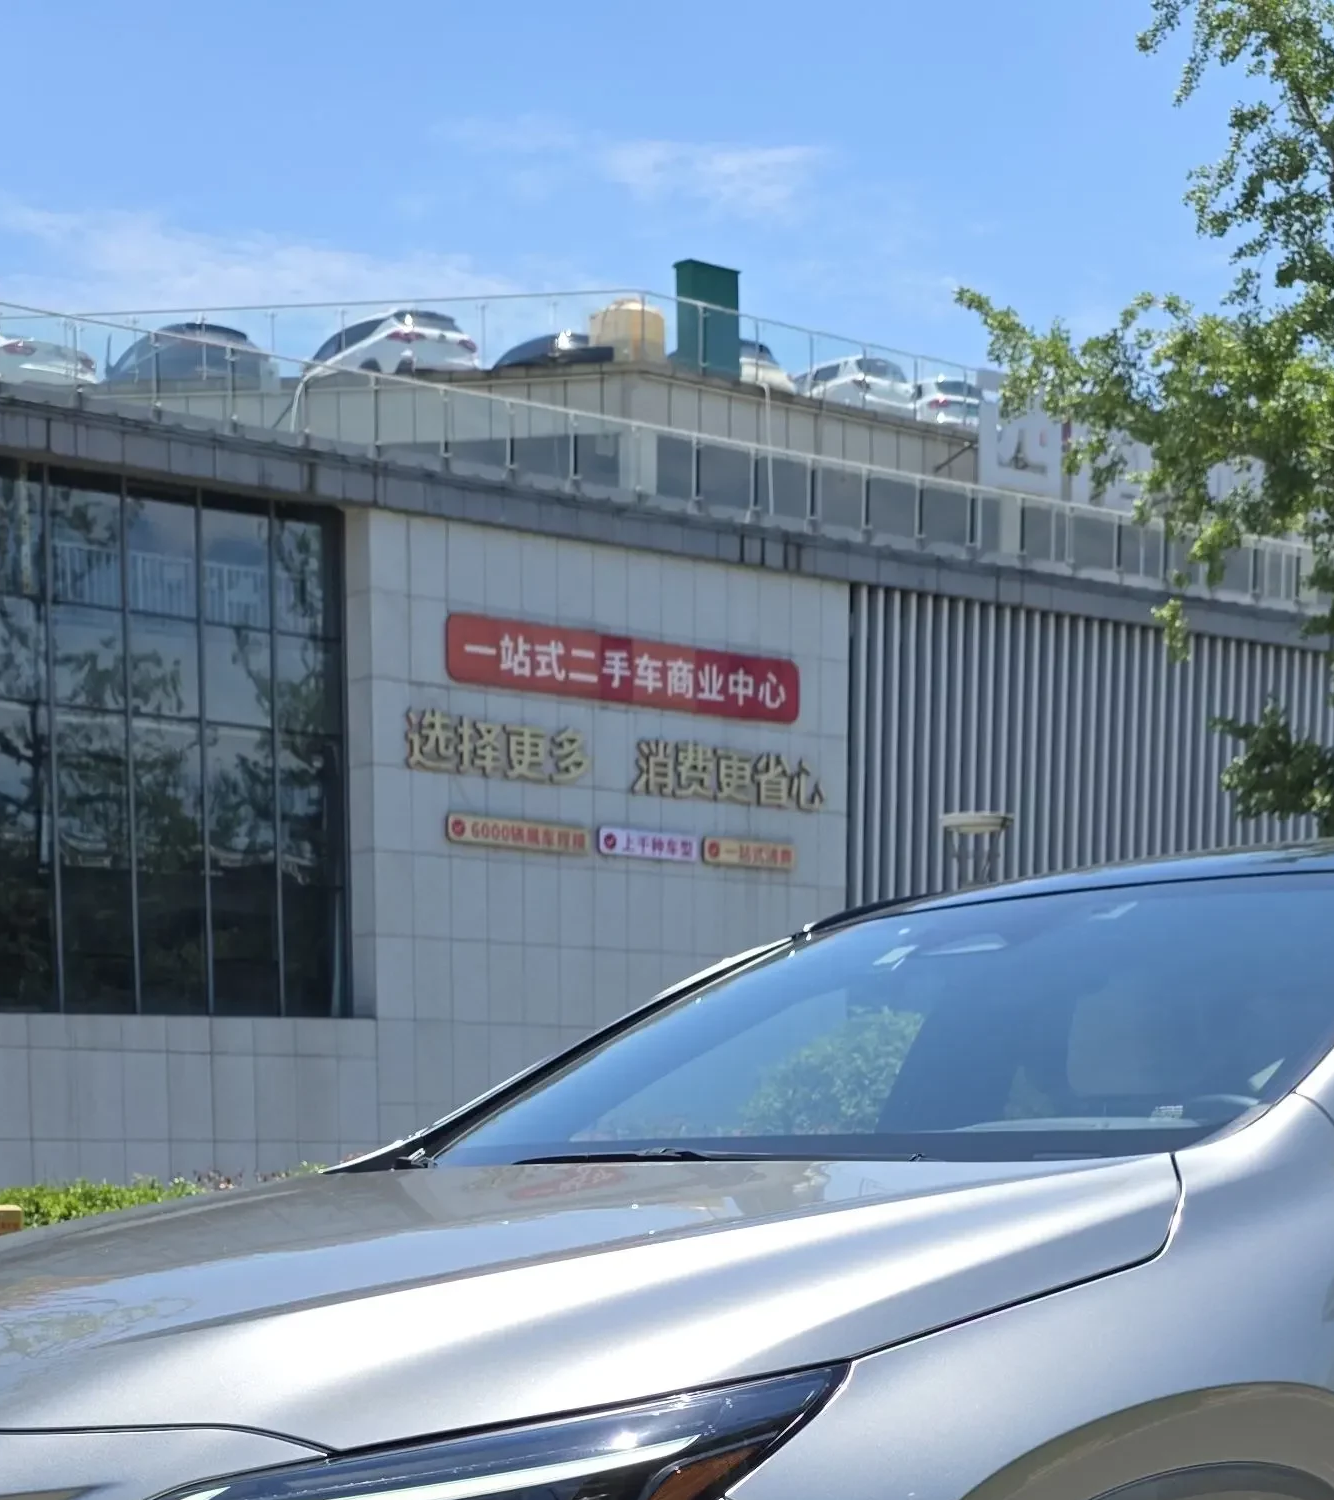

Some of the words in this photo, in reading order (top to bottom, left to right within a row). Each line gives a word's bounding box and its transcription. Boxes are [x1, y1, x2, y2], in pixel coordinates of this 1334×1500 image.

[464, 633, 786, 709] 一站式二手车商业中心
[407, 707, 589, 784] 选择更多
[633, 740, 825, 811] 消费更省心
